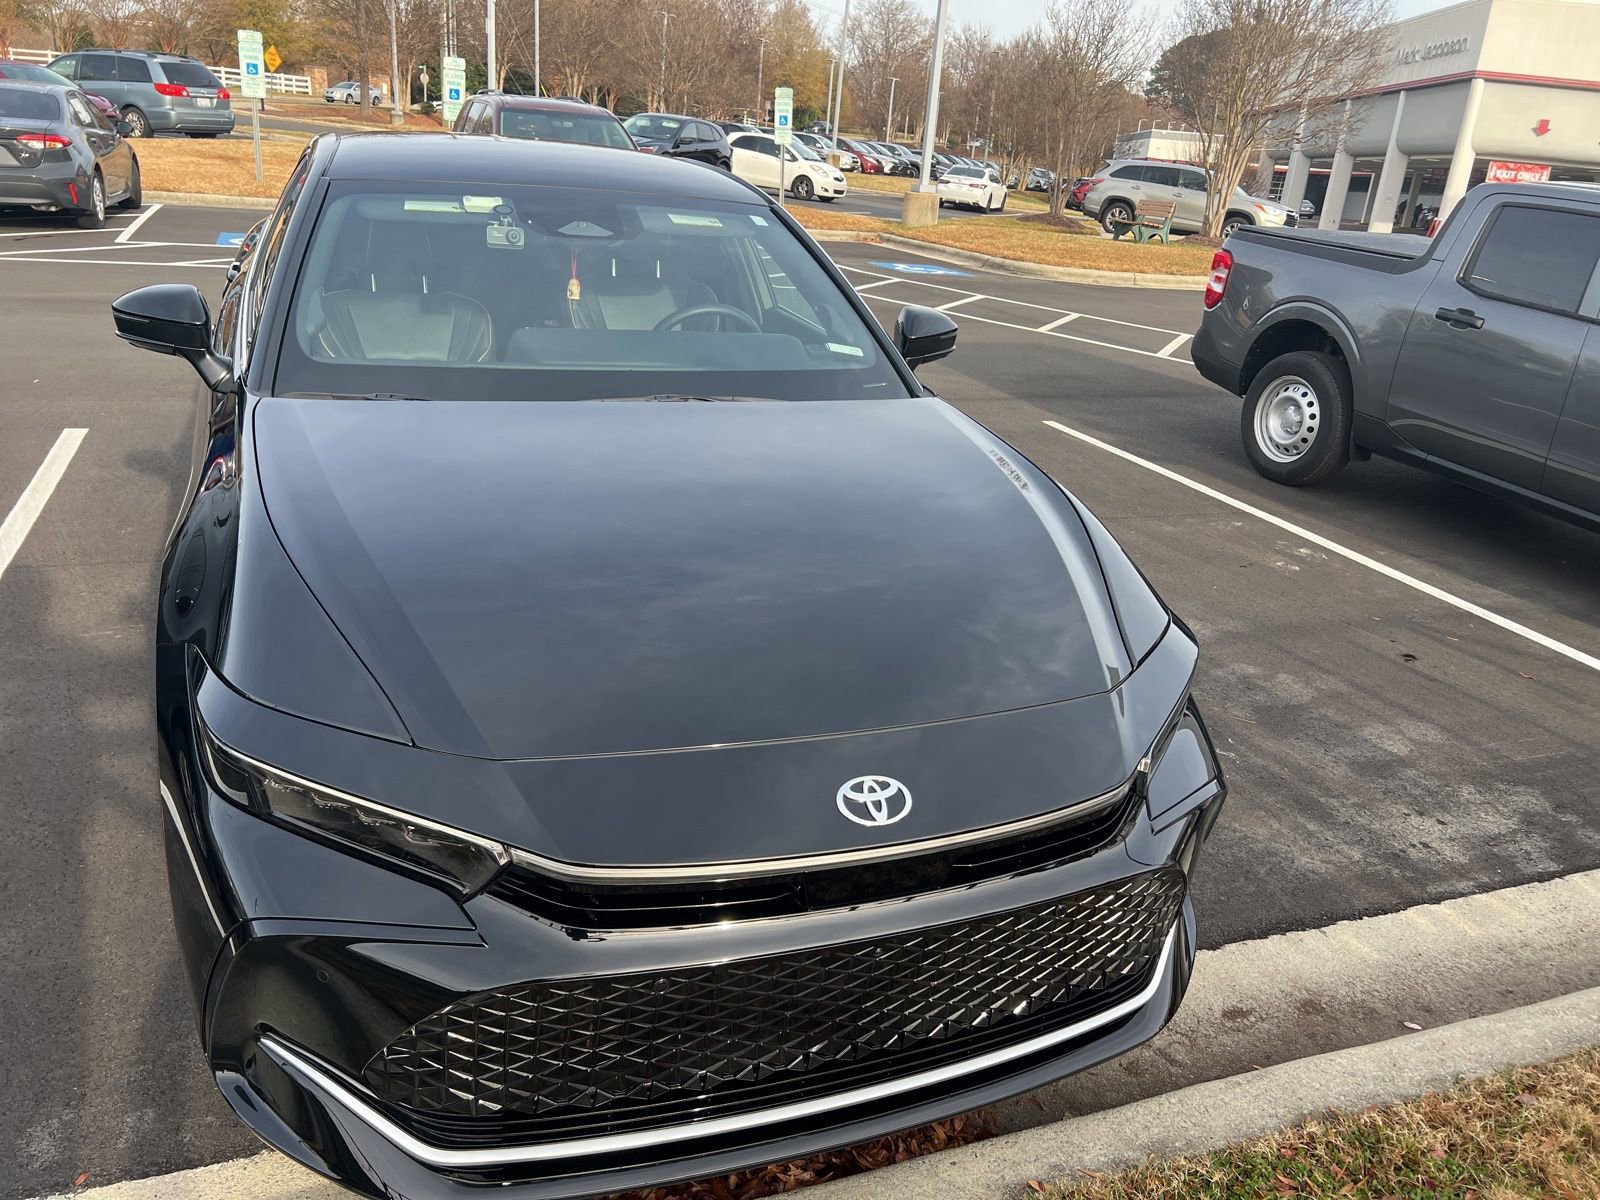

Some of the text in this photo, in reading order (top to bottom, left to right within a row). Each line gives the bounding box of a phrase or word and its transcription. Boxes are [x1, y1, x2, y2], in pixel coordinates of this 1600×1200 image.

[1396, 37, 1470, 65] Mark Jacobson
[1495, 169, 1542, 181] EXIT ONLY
